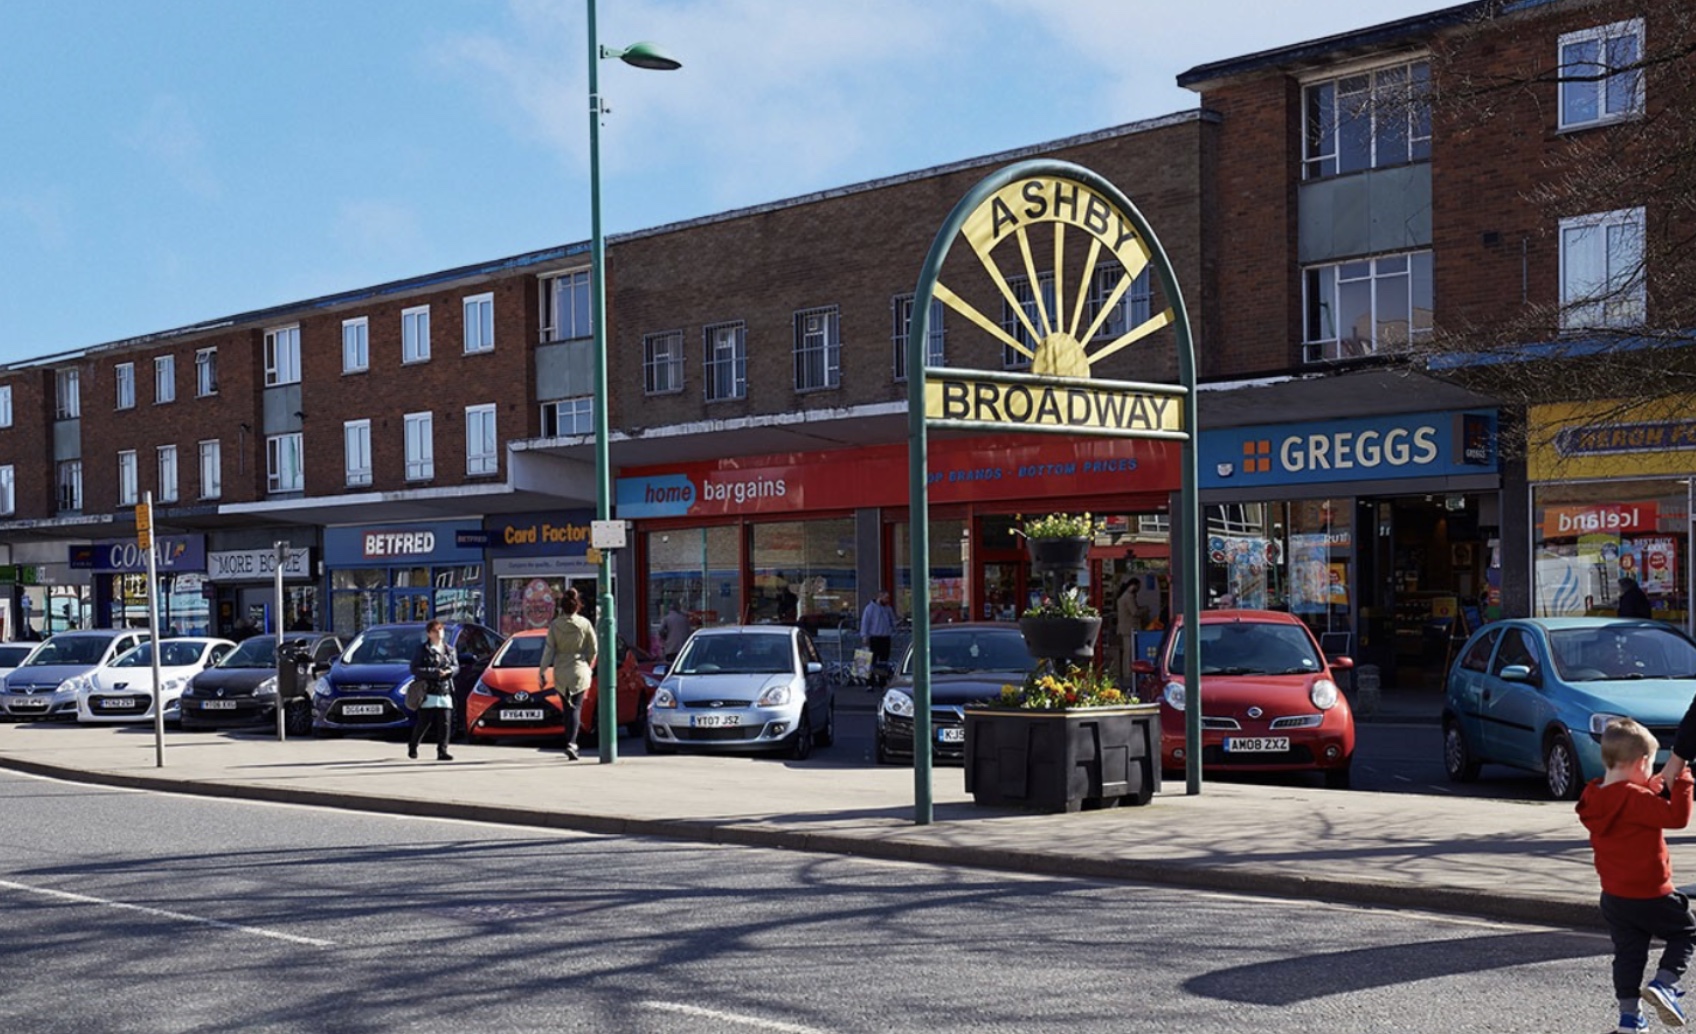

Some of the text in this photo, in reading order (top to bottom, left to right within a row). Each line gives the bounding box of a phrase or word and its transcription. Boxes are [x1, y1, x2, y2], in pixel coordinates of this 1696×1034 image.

[990, 181, 1138, 252] ASHBY
[942, 381, 1171, 431] BROADWAY
[1280, 427, 1437, 472] GREGGS
[927, 472, 944, 483] OP
[949, 468, 1002, 482] BRANDS
[1018, 463, 1076, 477] BOTTOM
[1084, 458, 1138, 472] PRICES
[645, 476, 786, 504] home bargains
[365, 532, 436, 555] BETFRED
[504, 525, 537, 544] Card
[218, 554, 301, 574] MORE BOZE
[697, 715, 739, 725] YT07 JSZ
[1231, 738, 1288, 751] AM08 ZXZ
